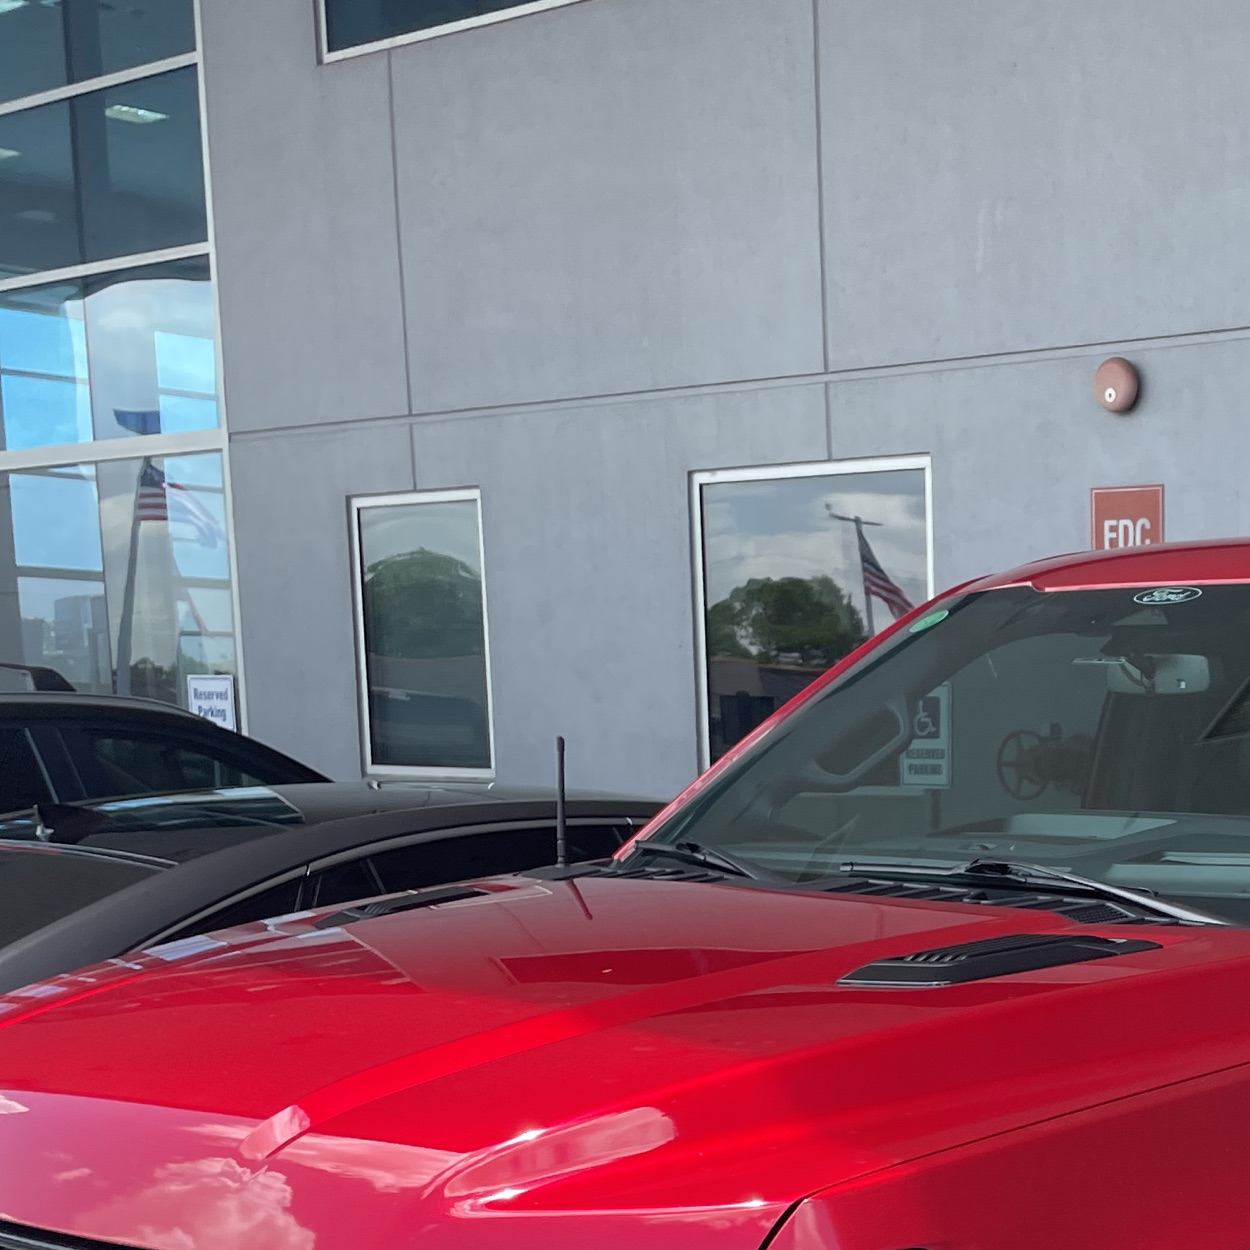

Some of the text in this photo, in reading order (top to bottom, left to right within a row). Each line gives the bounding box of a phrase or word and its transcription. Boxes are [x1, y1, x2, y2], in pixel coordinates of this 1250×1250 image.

[1142, 588, 1192, 602] Ford
[193, 687, 229, 701] Reserved
[197, 705, 227, 722] Parking
